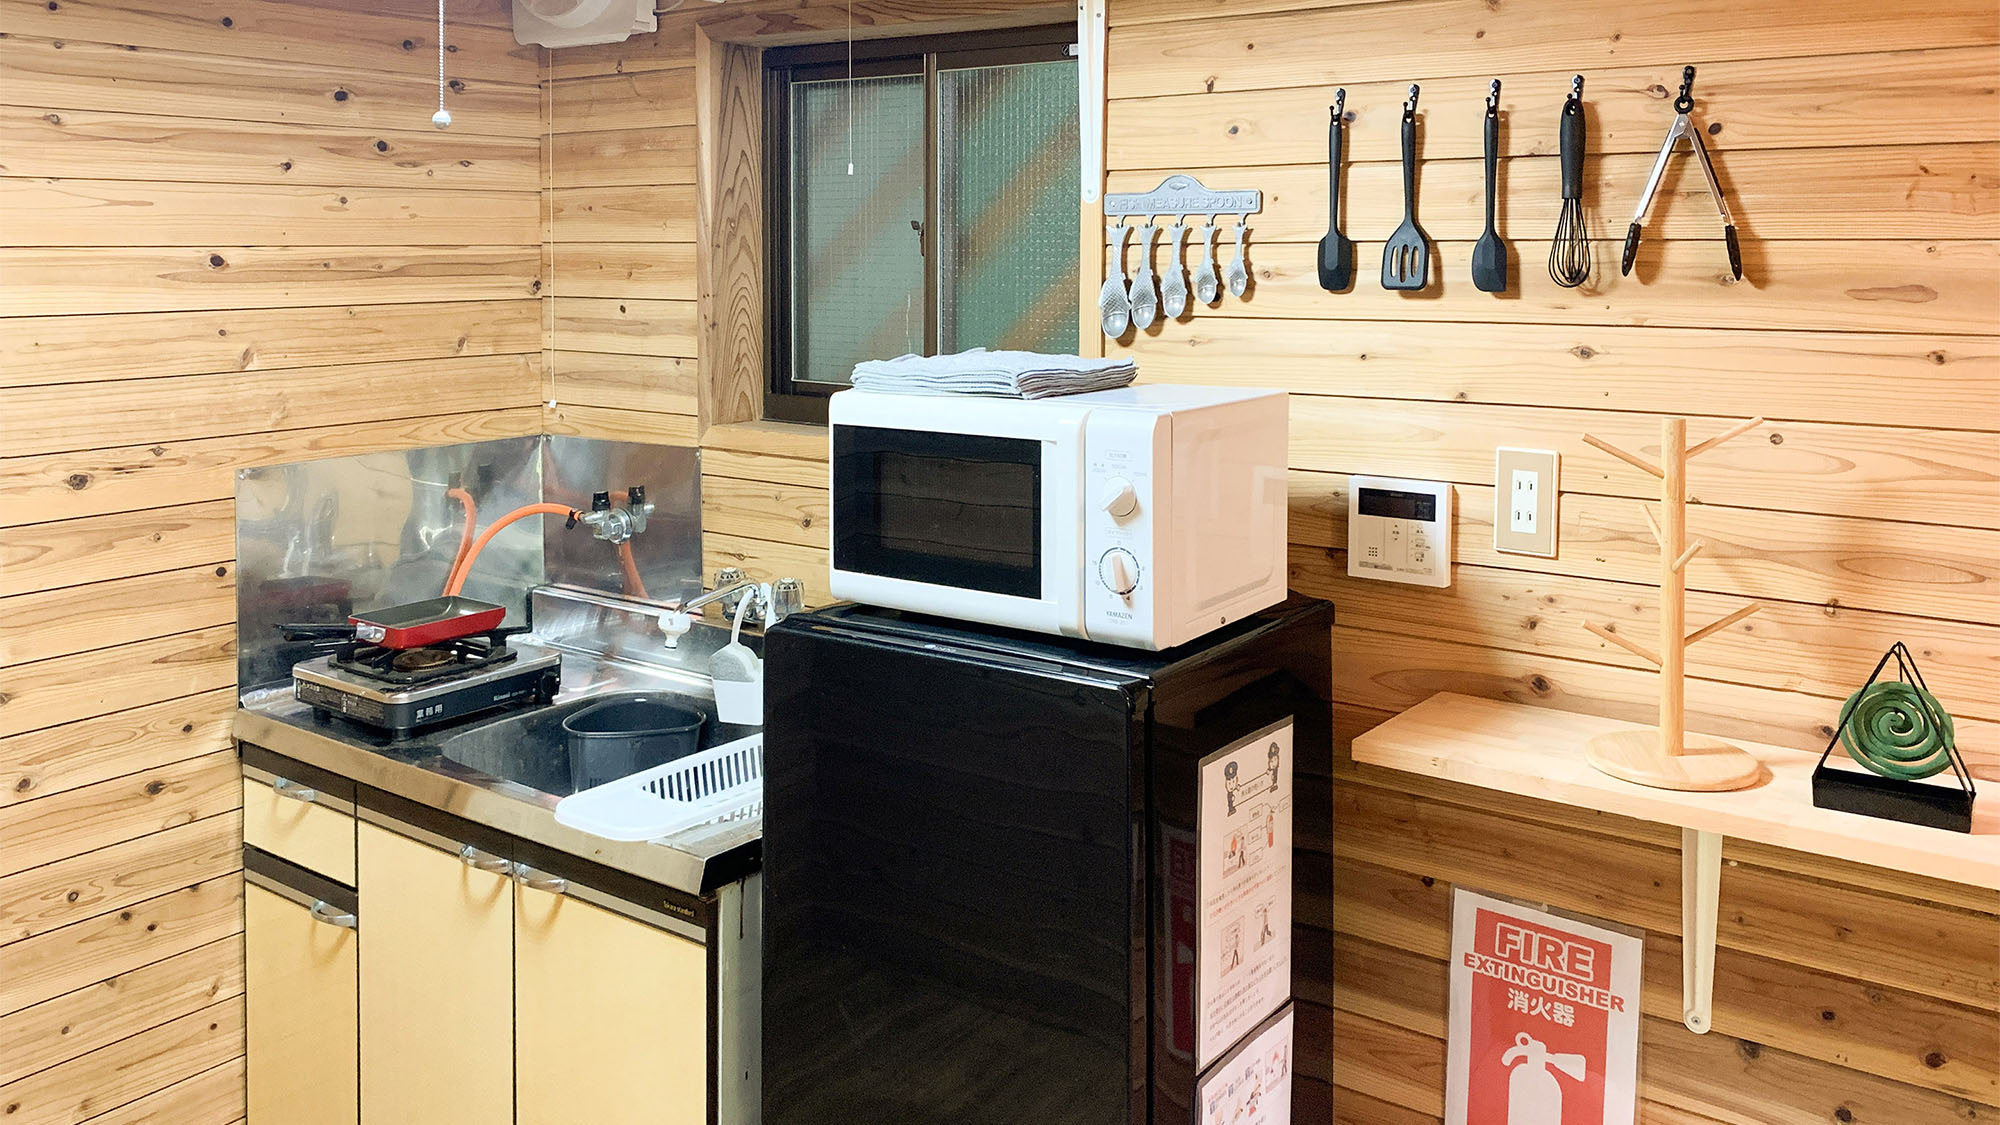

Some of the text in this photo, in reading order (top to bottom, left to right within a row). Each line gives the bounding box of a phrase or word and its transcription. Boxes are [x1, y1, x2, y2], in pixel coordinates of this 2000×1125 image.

[1146, 196, 1199, 209] MEASURE
[1201, 194, 1244, 208] SPOON
[1106, 610, 1133, 620] YAMAZEN
[1495, 922, 1594, 982] FIRE
[1464, 952, 1625, 1013] EXTINGUISHER
[1507, 987, 1575, 1028] 消火器
